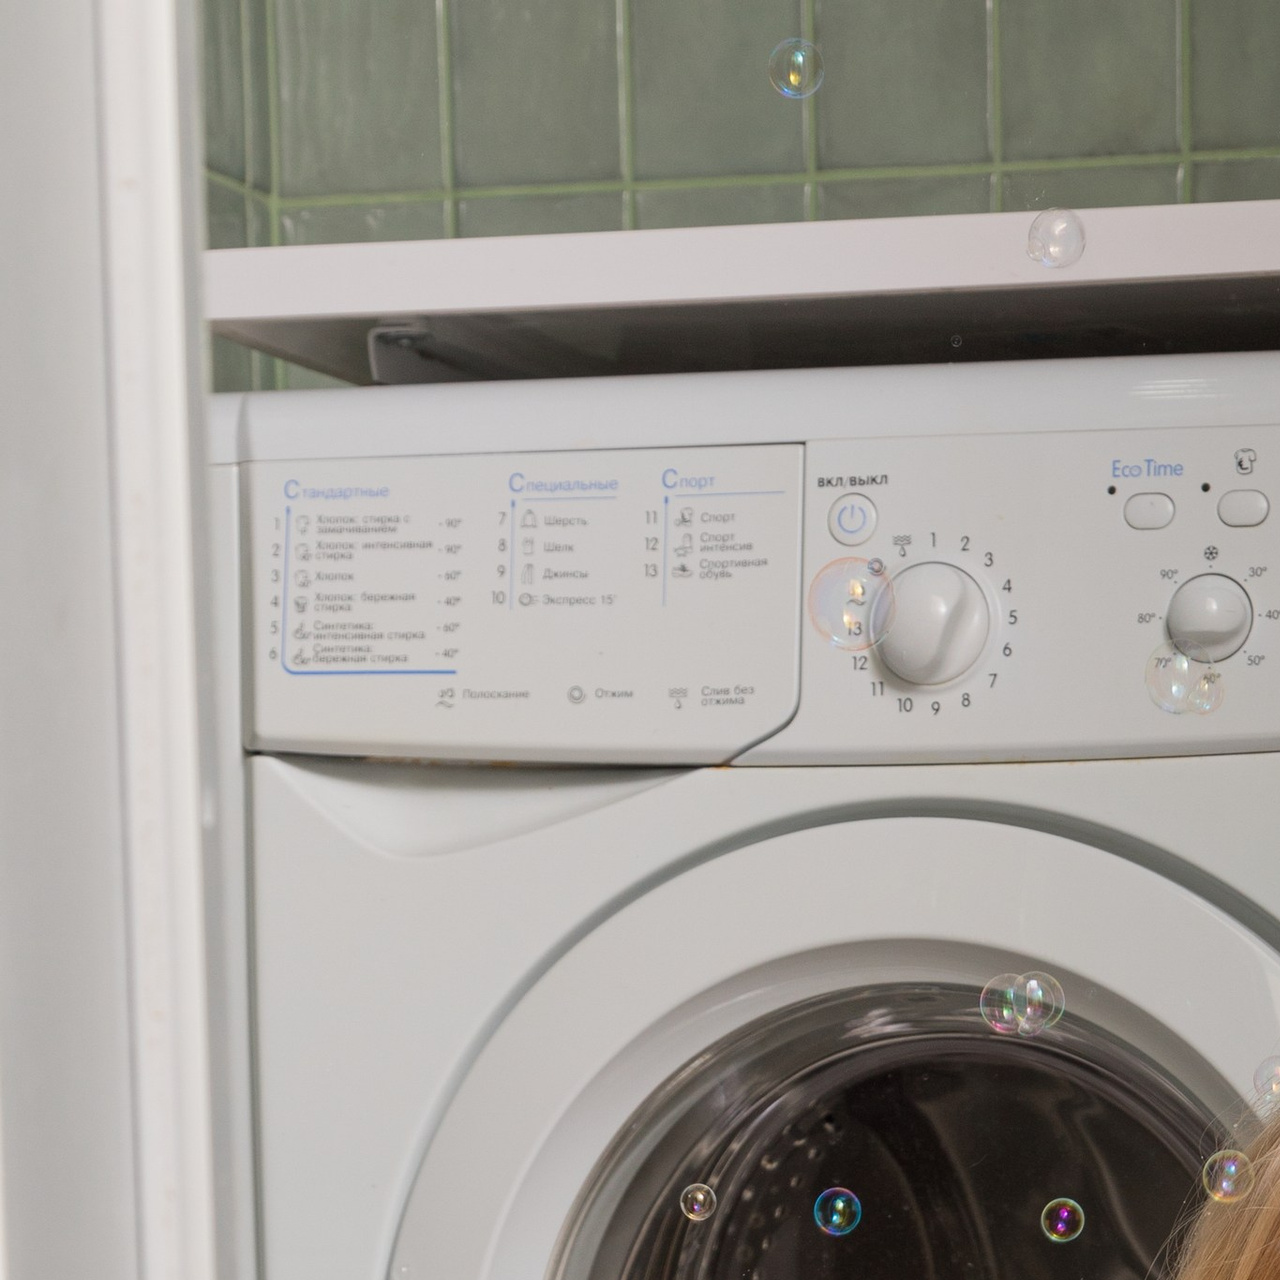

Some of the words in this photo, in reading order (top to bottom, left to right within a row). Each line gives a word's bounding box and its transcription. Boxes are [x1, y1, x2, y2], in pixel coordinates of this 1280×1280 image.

[1112, 460, 1142, 478] Eco
[1144, 459, 1184, 477] Time
[508, 472, 619, 493] Специальные
[661, 468, 715, 490] Спорт
[817, 474, 889, 488] ВКЛ/ВЫКЛ
[283, 479, 389, 500] Стандартные
[498, 511, 507, 525] 7
[645, 511, 658, 524] 11
[700, 512, 736, 524] Спорт
[645, 537, 659, 551] 12
[699, 532, 736, 543] Спорт
[930, 532, 936, 547] 1
[961, 536, 971, 551] 2
[271, 543, 280, 556] 2
[498, 539, 507, 552] 8
[699, 558, 769, 570] Спортивная
[984, 552, 994, 567] 3
[271, 570, 280, 583] 3
[496, 564, 506, 578] 9
[644, 564, 659, 578] 13
[1002, 579, 1012, 593] 4
[270, 596, 279, 608] 4
[491, 590, 507, 605] 10
[541, 594, 597, 606] Экспресс
[1009, 610, 1018, 625] 5
[270, 622, 279, 634] 5
[269, 649, 278, 661] 6
[1003, 642, 1013, 657] 6
[852, 656, 868, 671] 12
[988, 673, 998, 688] 7
[462, 688, 530, 699] Полоскание
[594, 688, 634, 699] Отжим
[701, 685, 731, 696] Слив
[733, 684, 755, 696] без
[871, 681, 885, 696] 11
[897, 698, 914, 713] 10
[961, 693, 971, 708] 8
[931, 701, 941, 716] 9
